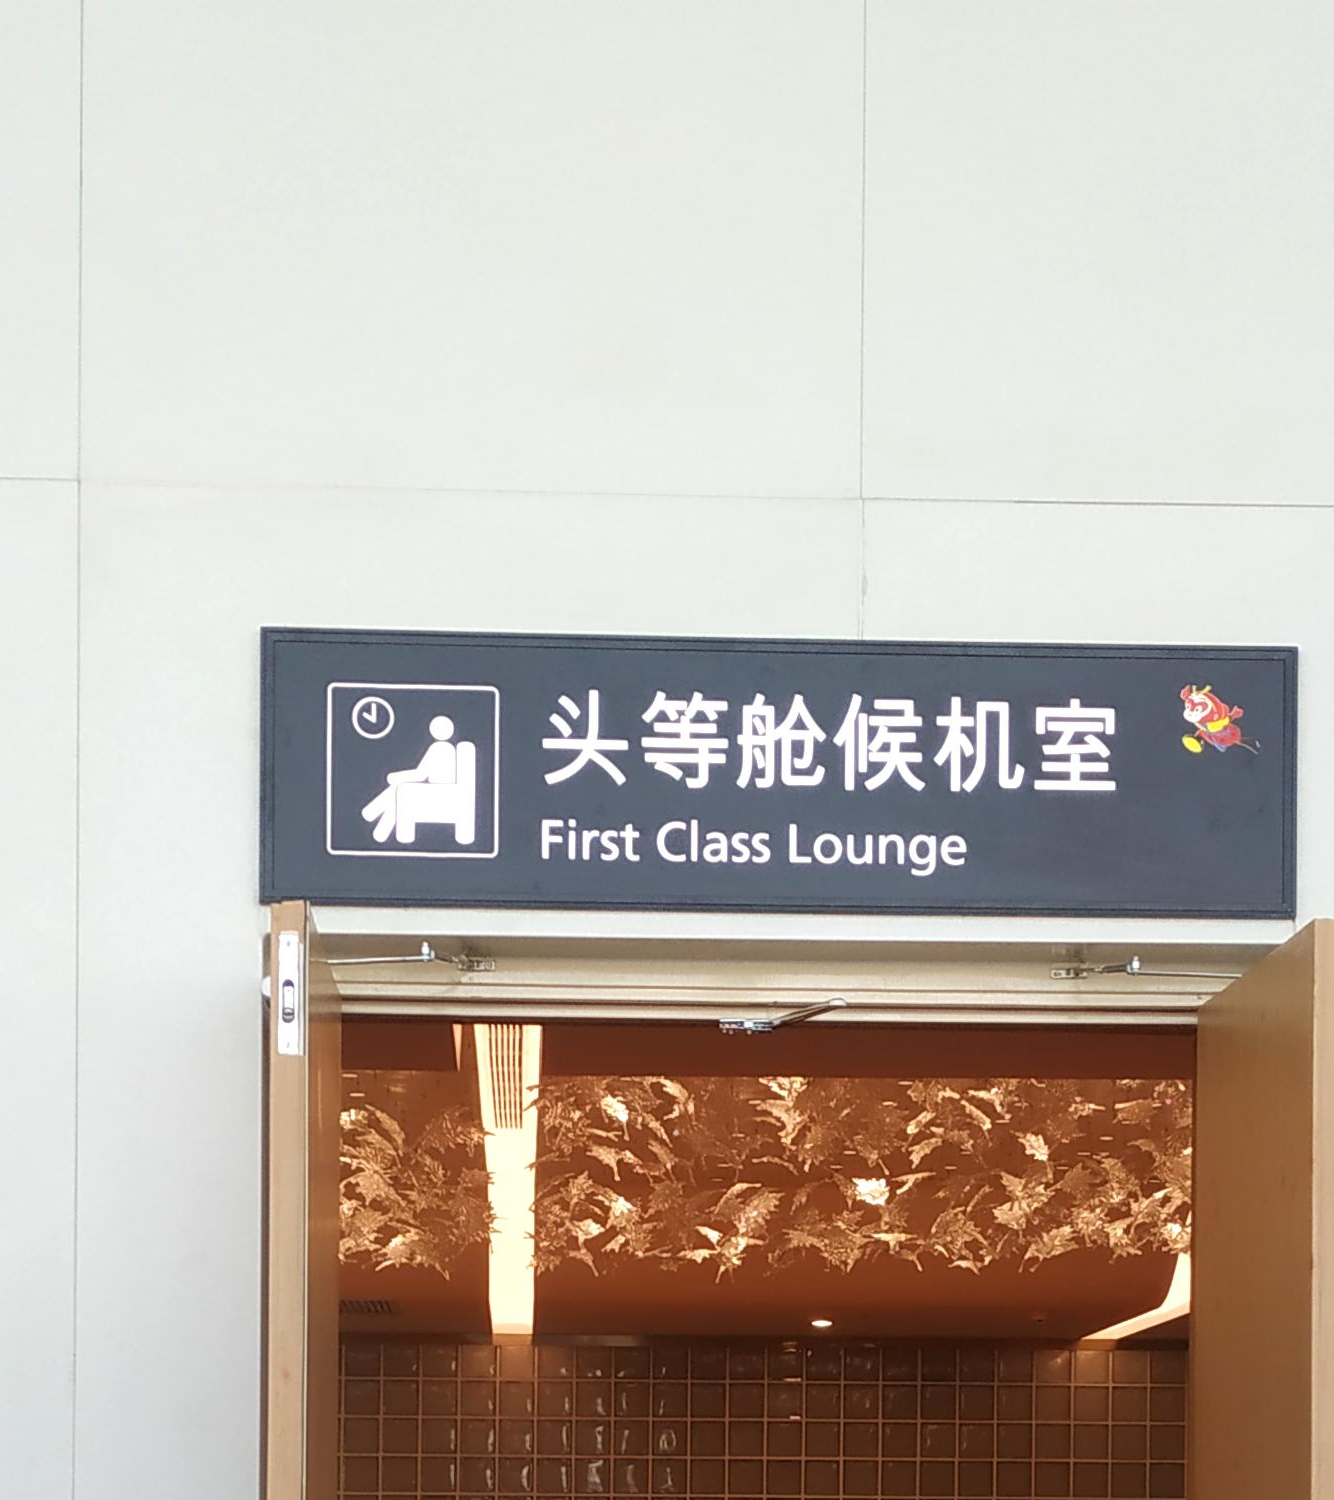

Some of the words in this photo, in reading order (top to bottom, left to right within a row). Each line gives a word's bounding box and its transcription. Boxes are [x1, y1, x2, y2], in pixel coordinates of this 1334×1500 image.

[540, 688, 1118, 793] 头等舱候机室
[540, 817, 642, 862] First
[655, 818, 773, 865] Class
[787, 822, 969, 878] Lounge
